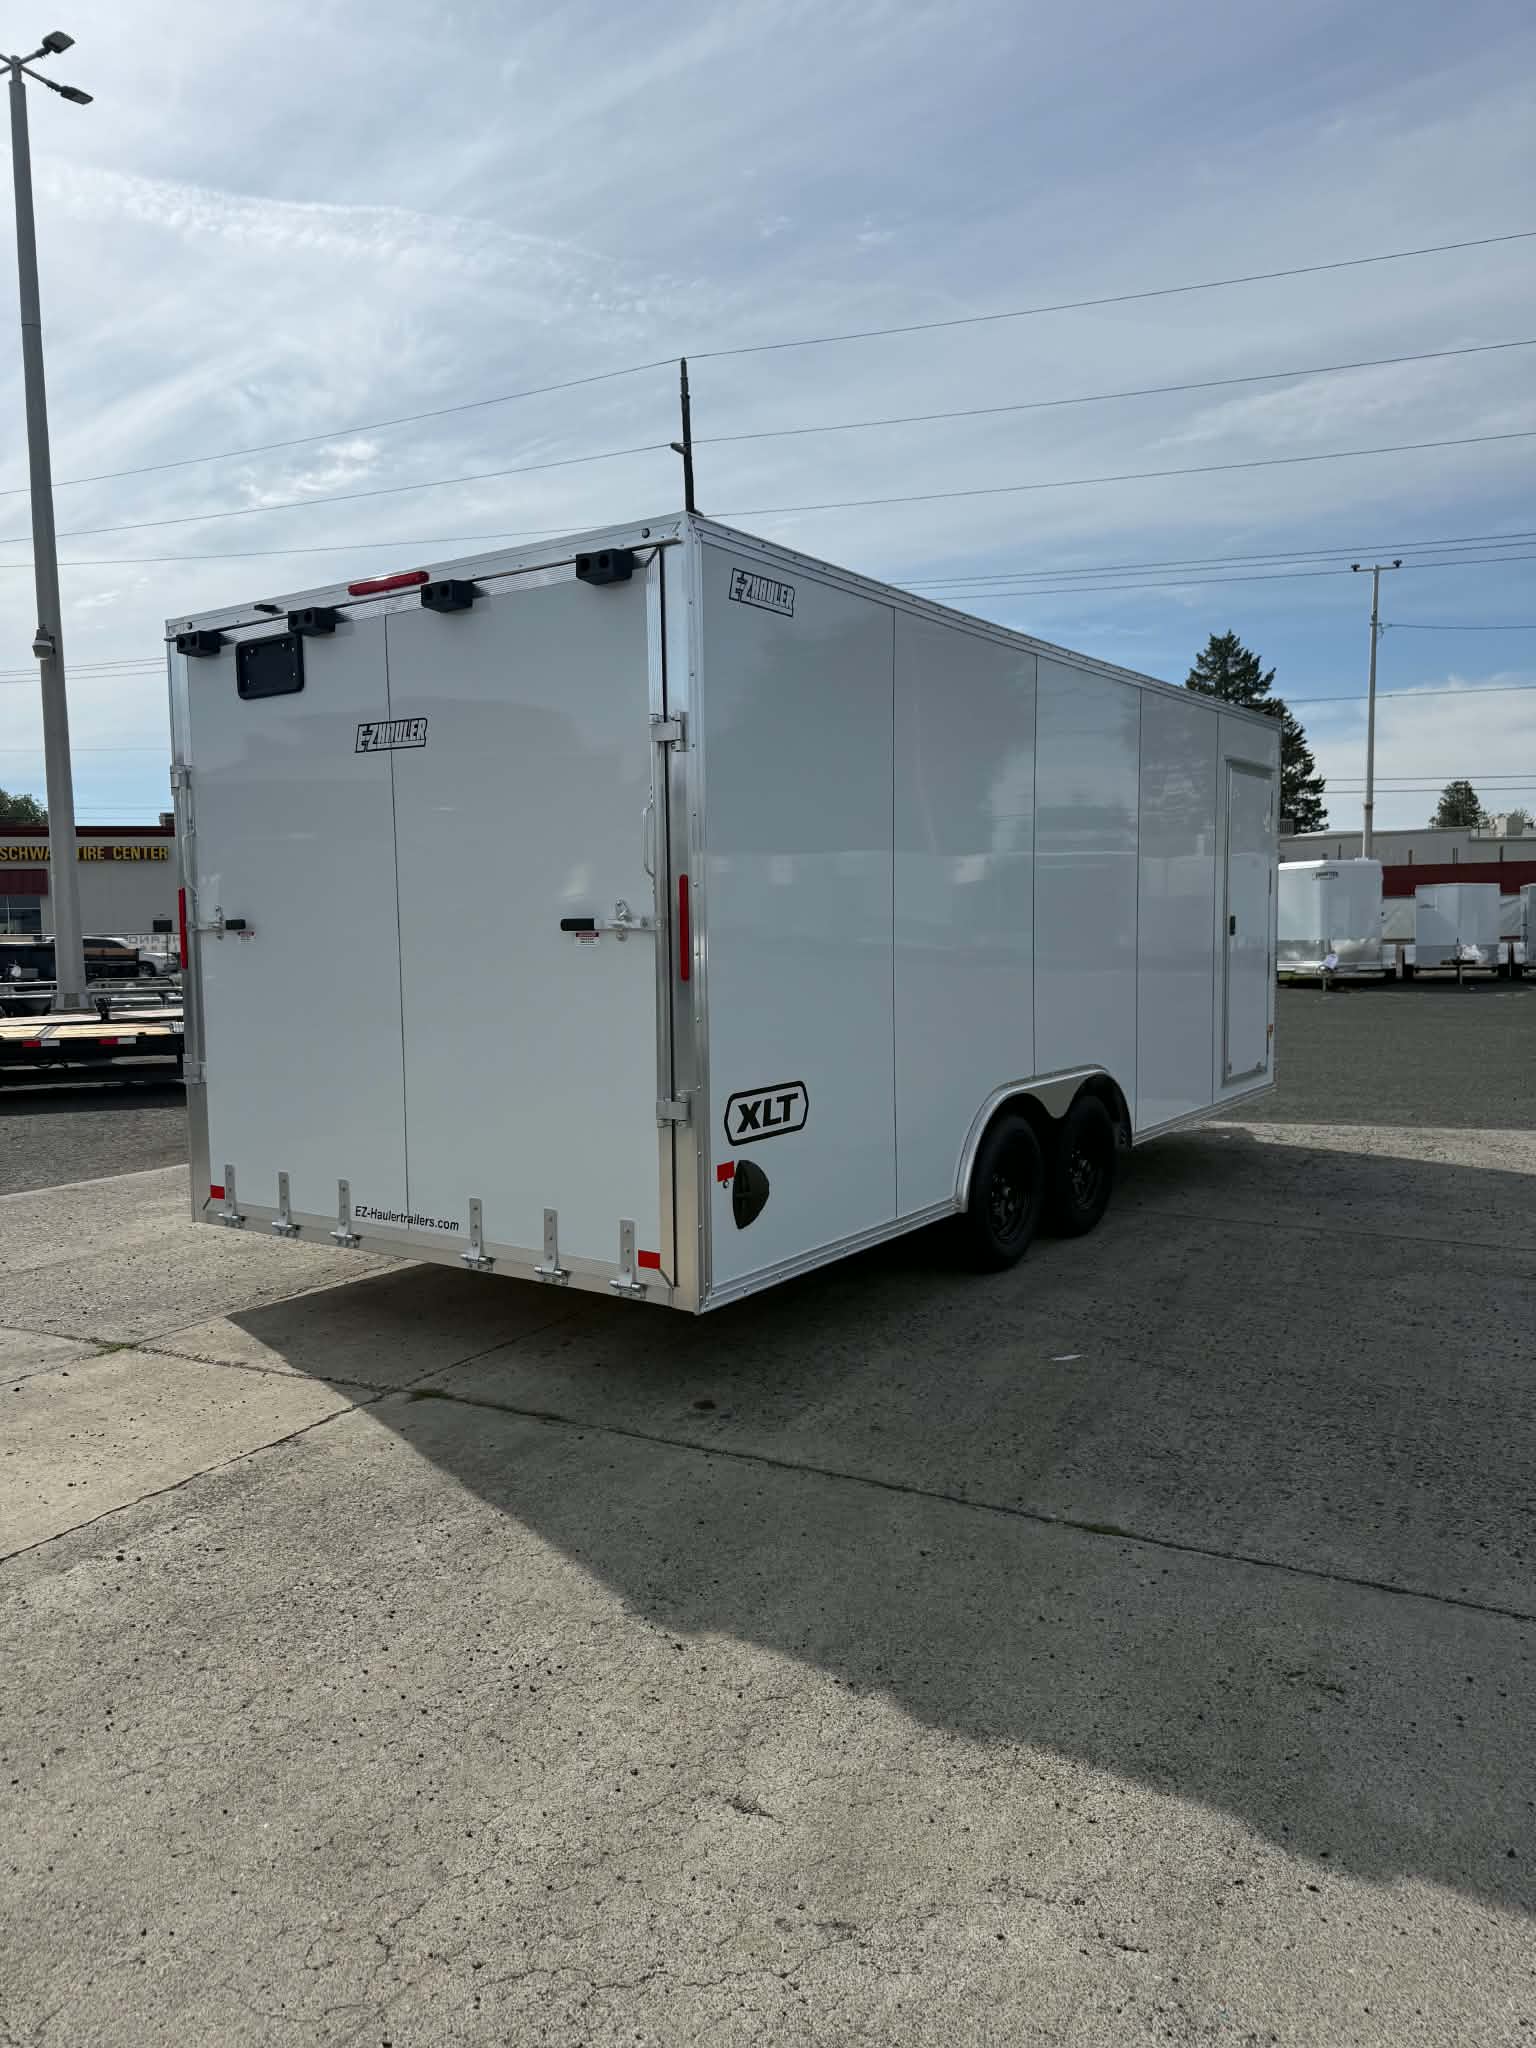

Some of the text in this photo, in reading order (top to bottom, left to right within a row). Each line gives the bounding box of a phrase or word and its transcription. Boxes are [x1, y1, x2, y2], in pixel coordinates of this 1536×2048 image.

[0, 846, 50, 861] SCHWA
[112, 846, 168, 861] CENTER
[736, 1092, 799, 1133] XLT
[355, 1205, 459, 1231] EZ-Haulertrailers.com
